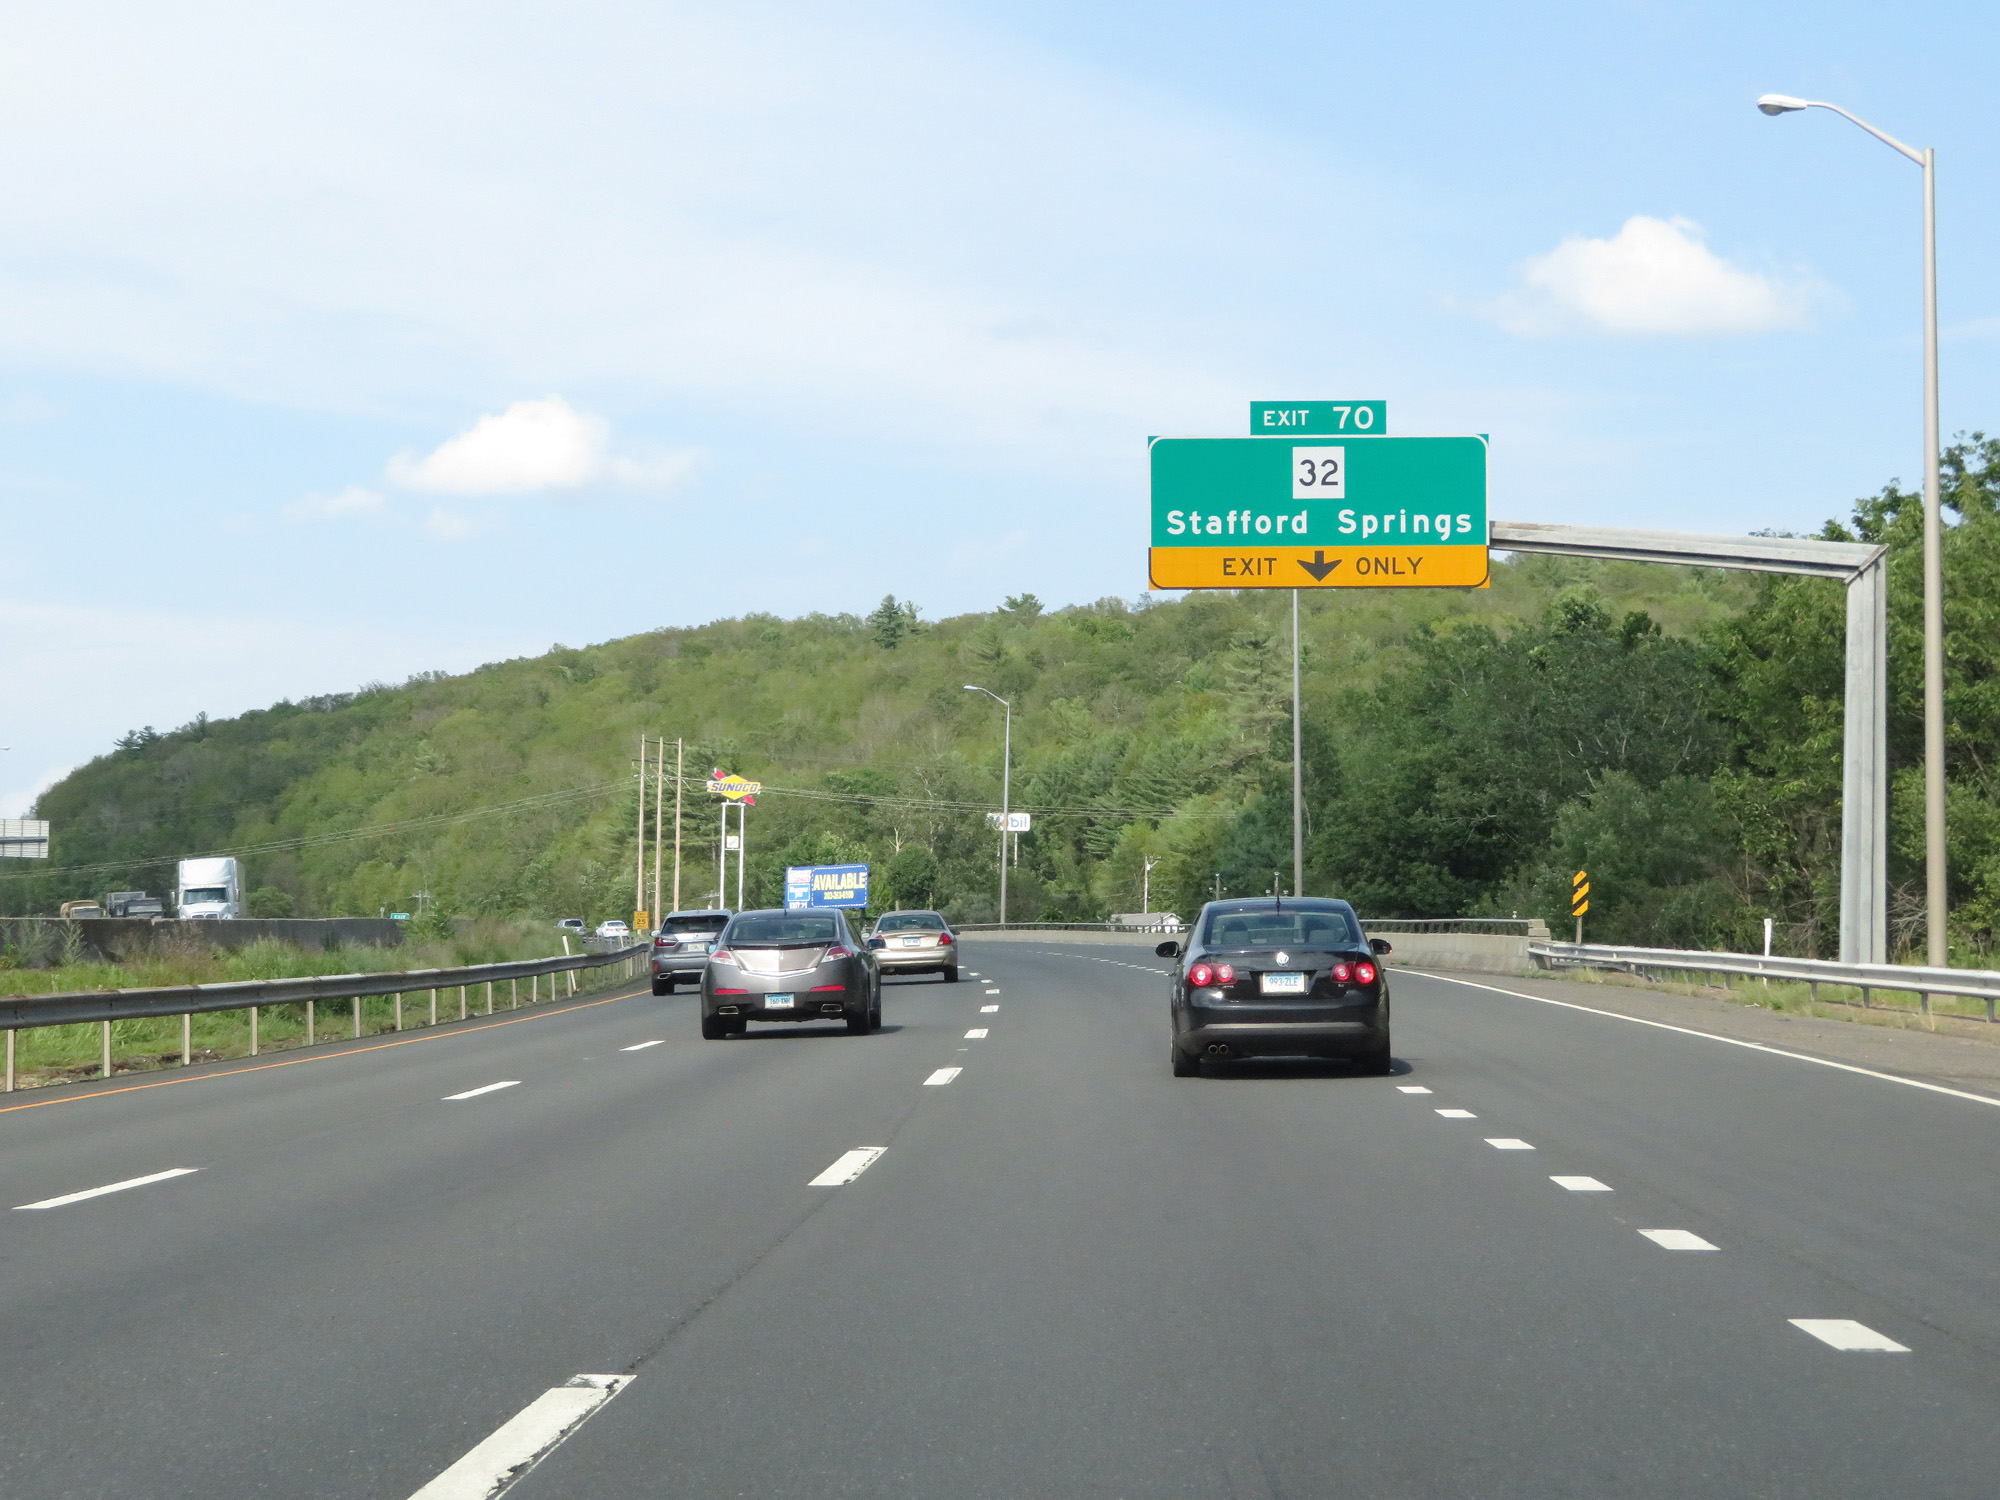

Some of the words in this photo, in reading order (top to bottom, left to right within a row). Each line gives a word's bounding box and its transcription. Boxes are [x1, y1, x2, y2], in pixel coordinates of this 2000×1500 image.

[1263, 410, 1310, 426] EXIT
[1332, 405, 1374, 430] 70
[1298, 458, 1339, 487] 32
[1166, 509, 1308, 536] Stafford
[1337, 508, 1473, 542] Springs
[1223, 557, 1277, 576] EXIT
[1355, 556, 1424, 576] ONLY
[711, 782, 759, 793] SUNOCO
[813, 871, 867, 891] AVAILABLE
